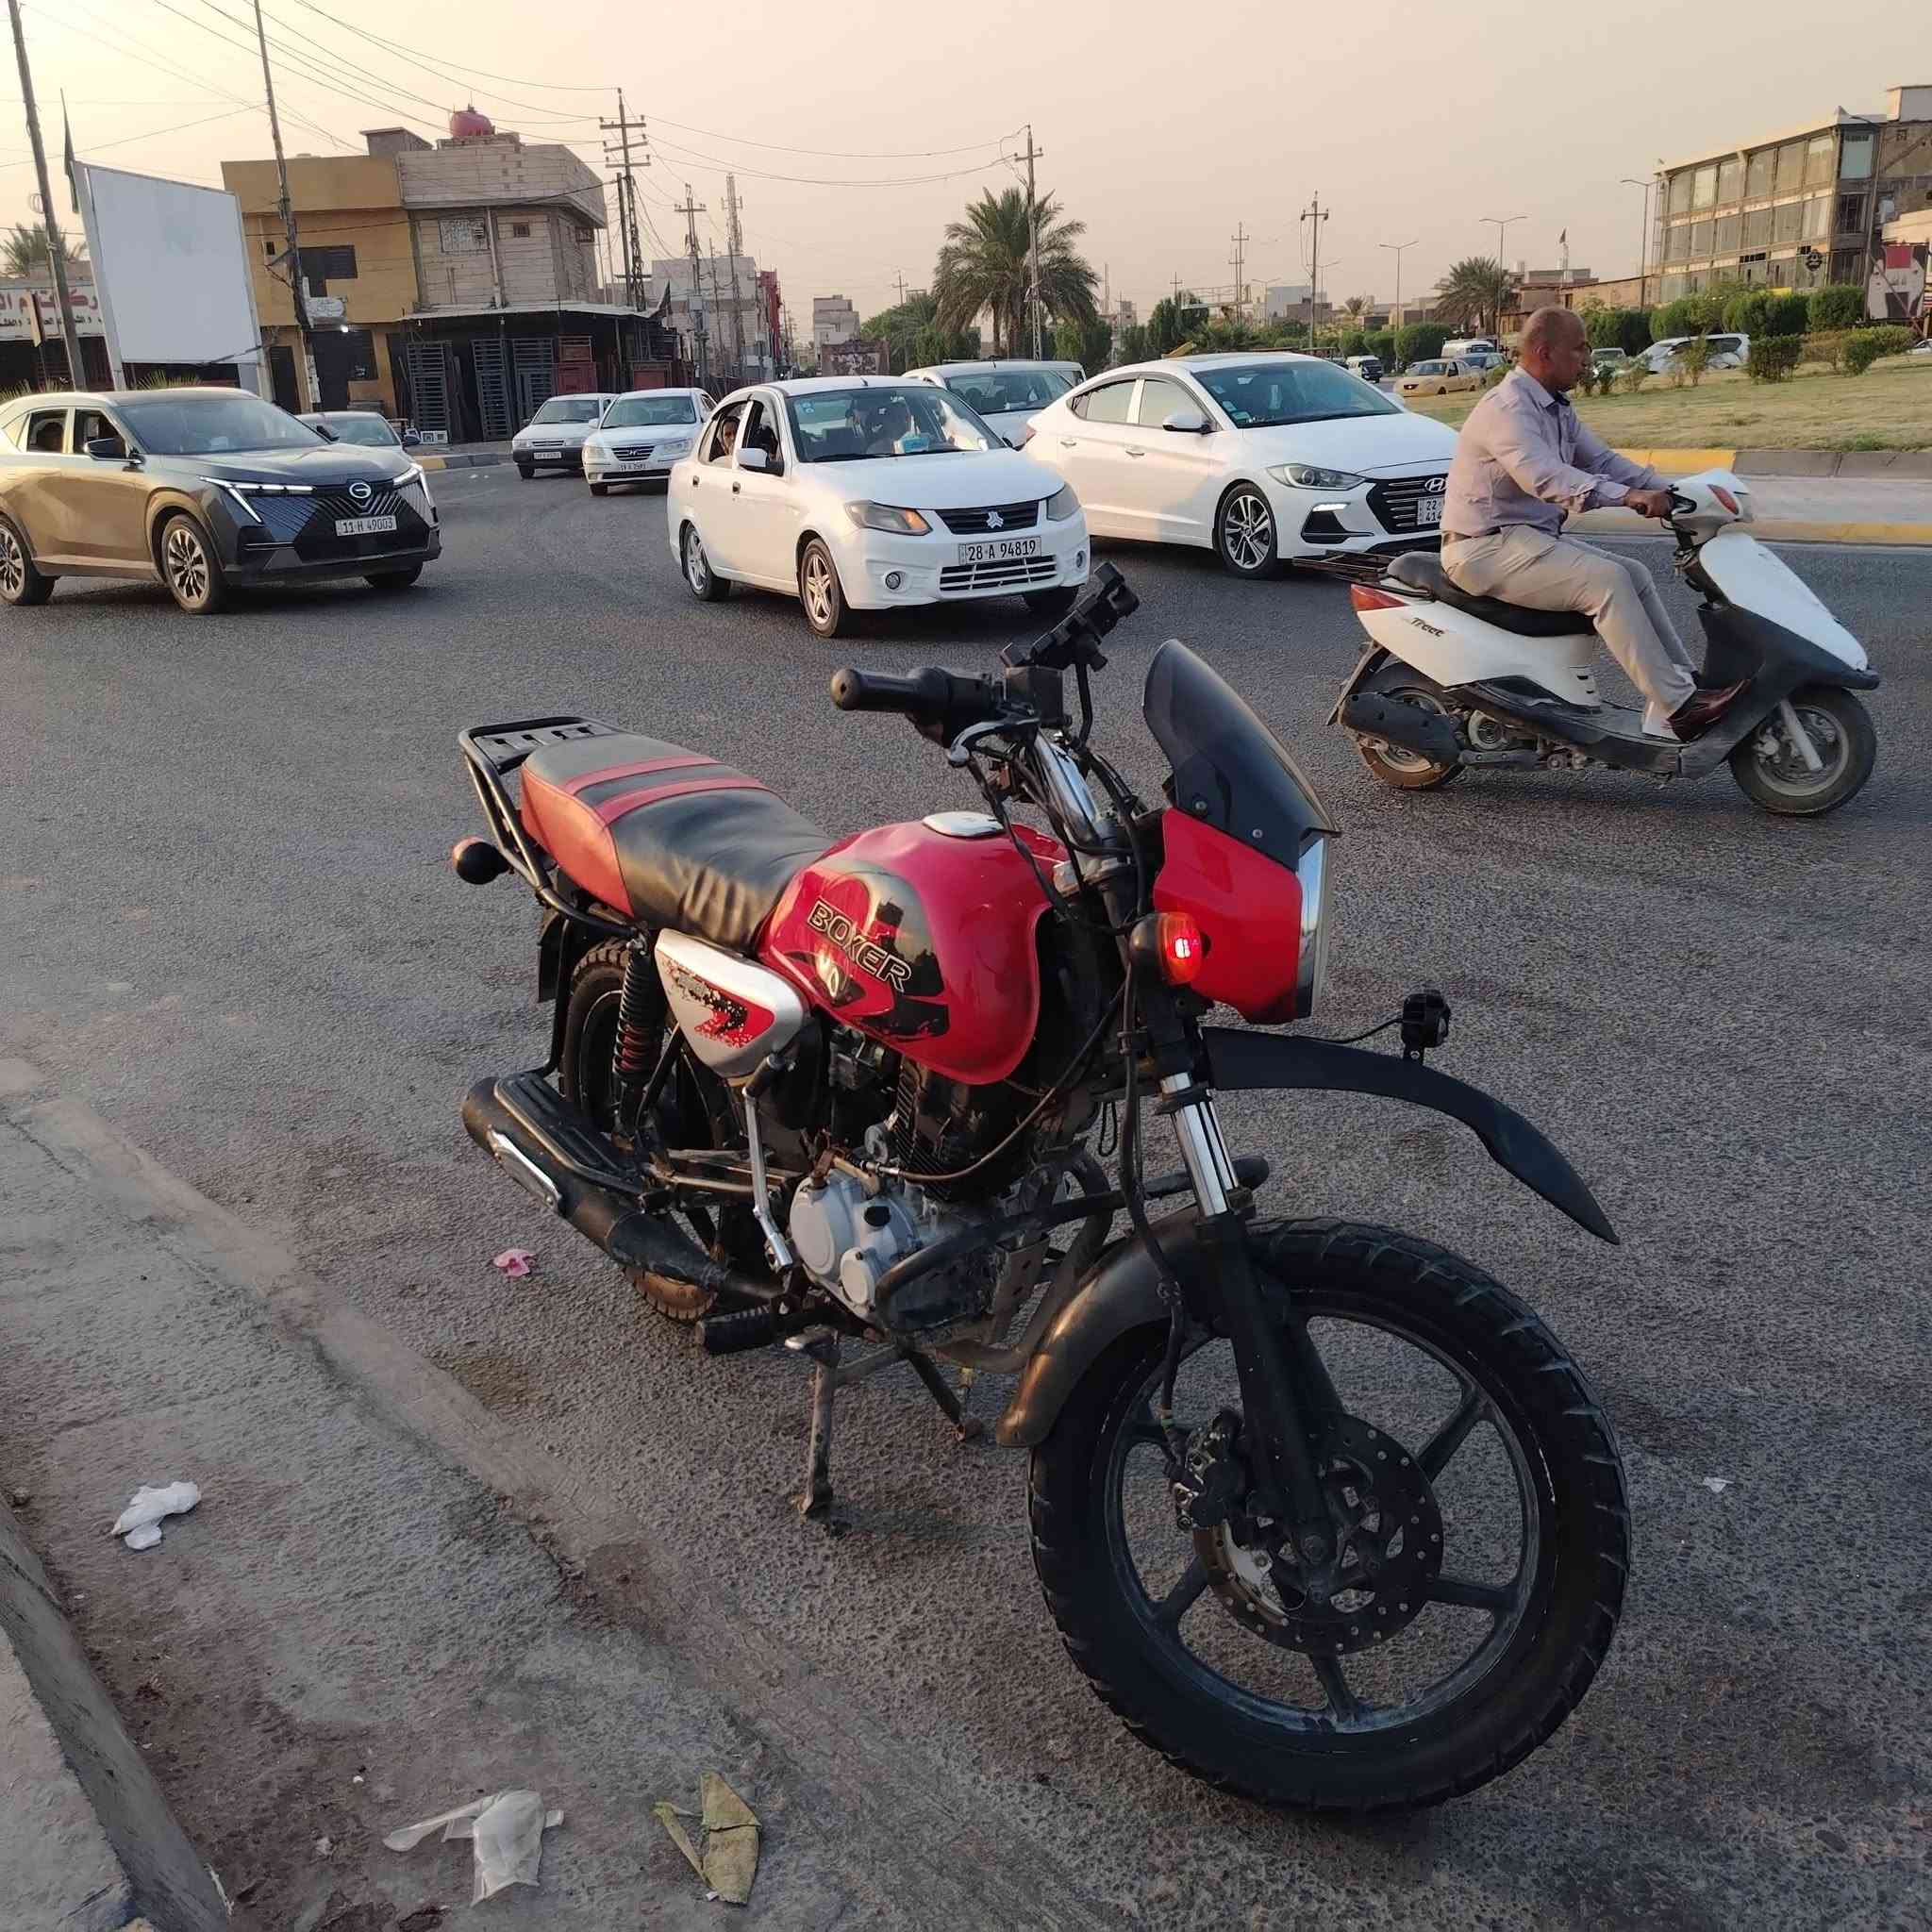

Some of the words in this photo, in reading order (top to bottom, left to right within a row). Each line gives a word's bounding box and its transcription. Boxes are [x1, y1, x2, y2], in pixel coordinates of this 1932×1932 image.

[968, 546, 983, 561] 28
[989, 544, 995, 559] A
[1000, 540, 1036, 558] 94819
[808, 898, 912, 993] BOXER
